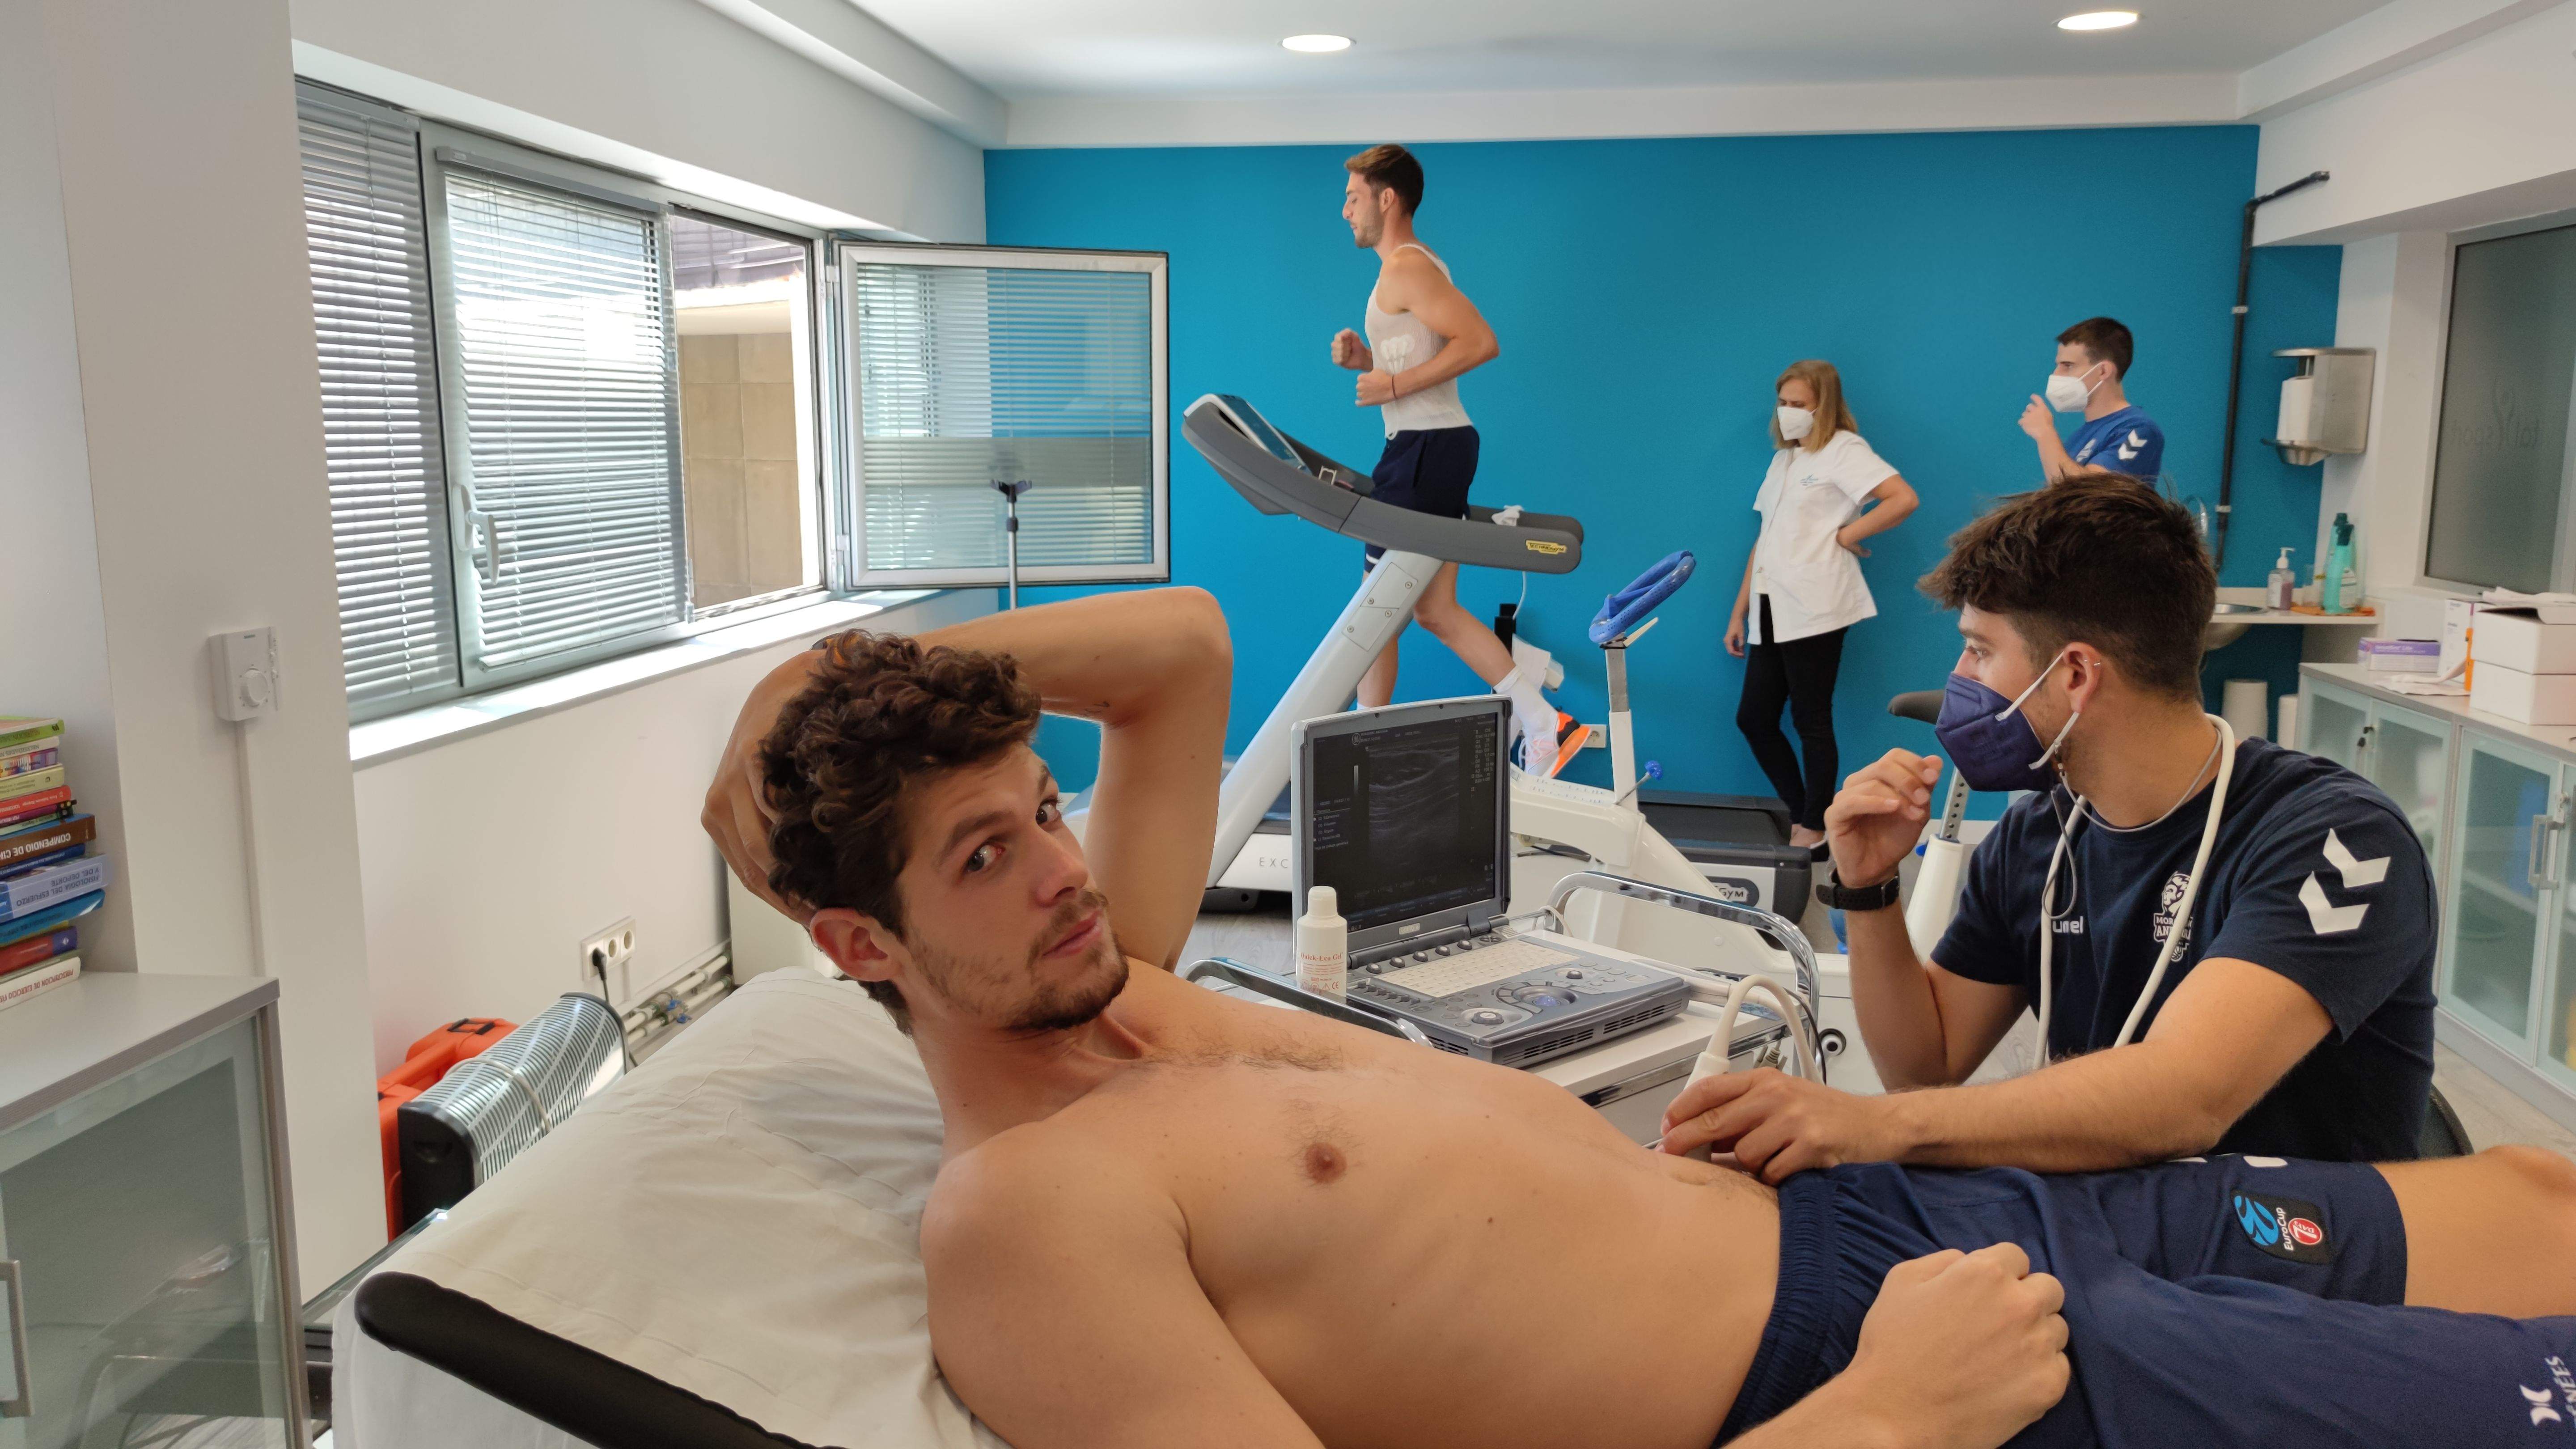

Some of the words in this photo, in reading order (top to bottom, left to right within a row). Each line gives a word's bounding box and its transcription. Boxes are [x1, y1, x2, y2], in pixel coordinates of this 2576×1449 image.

[25, 832, 71, 853] COMPENDIO
[12, 845, 23, 856] DE
[1259, 857, 1288, 869] EXC
[81, 868, 93, 876] DEL
[50, 873, 79, 886] DEPORTE
[64, 874, 99, 890] FISIOLOGÍA
[50, 886, 63, 894] DEL
[16, 890, 49, 906] ESFUERZO
[1301, 952, 1331, 961] Quick-Eco
[8, 984, 32, 998] EJERCICIO
[33, 981, 39, 989] DE
[2276, 1207, 2294, 1252] EuroCup
